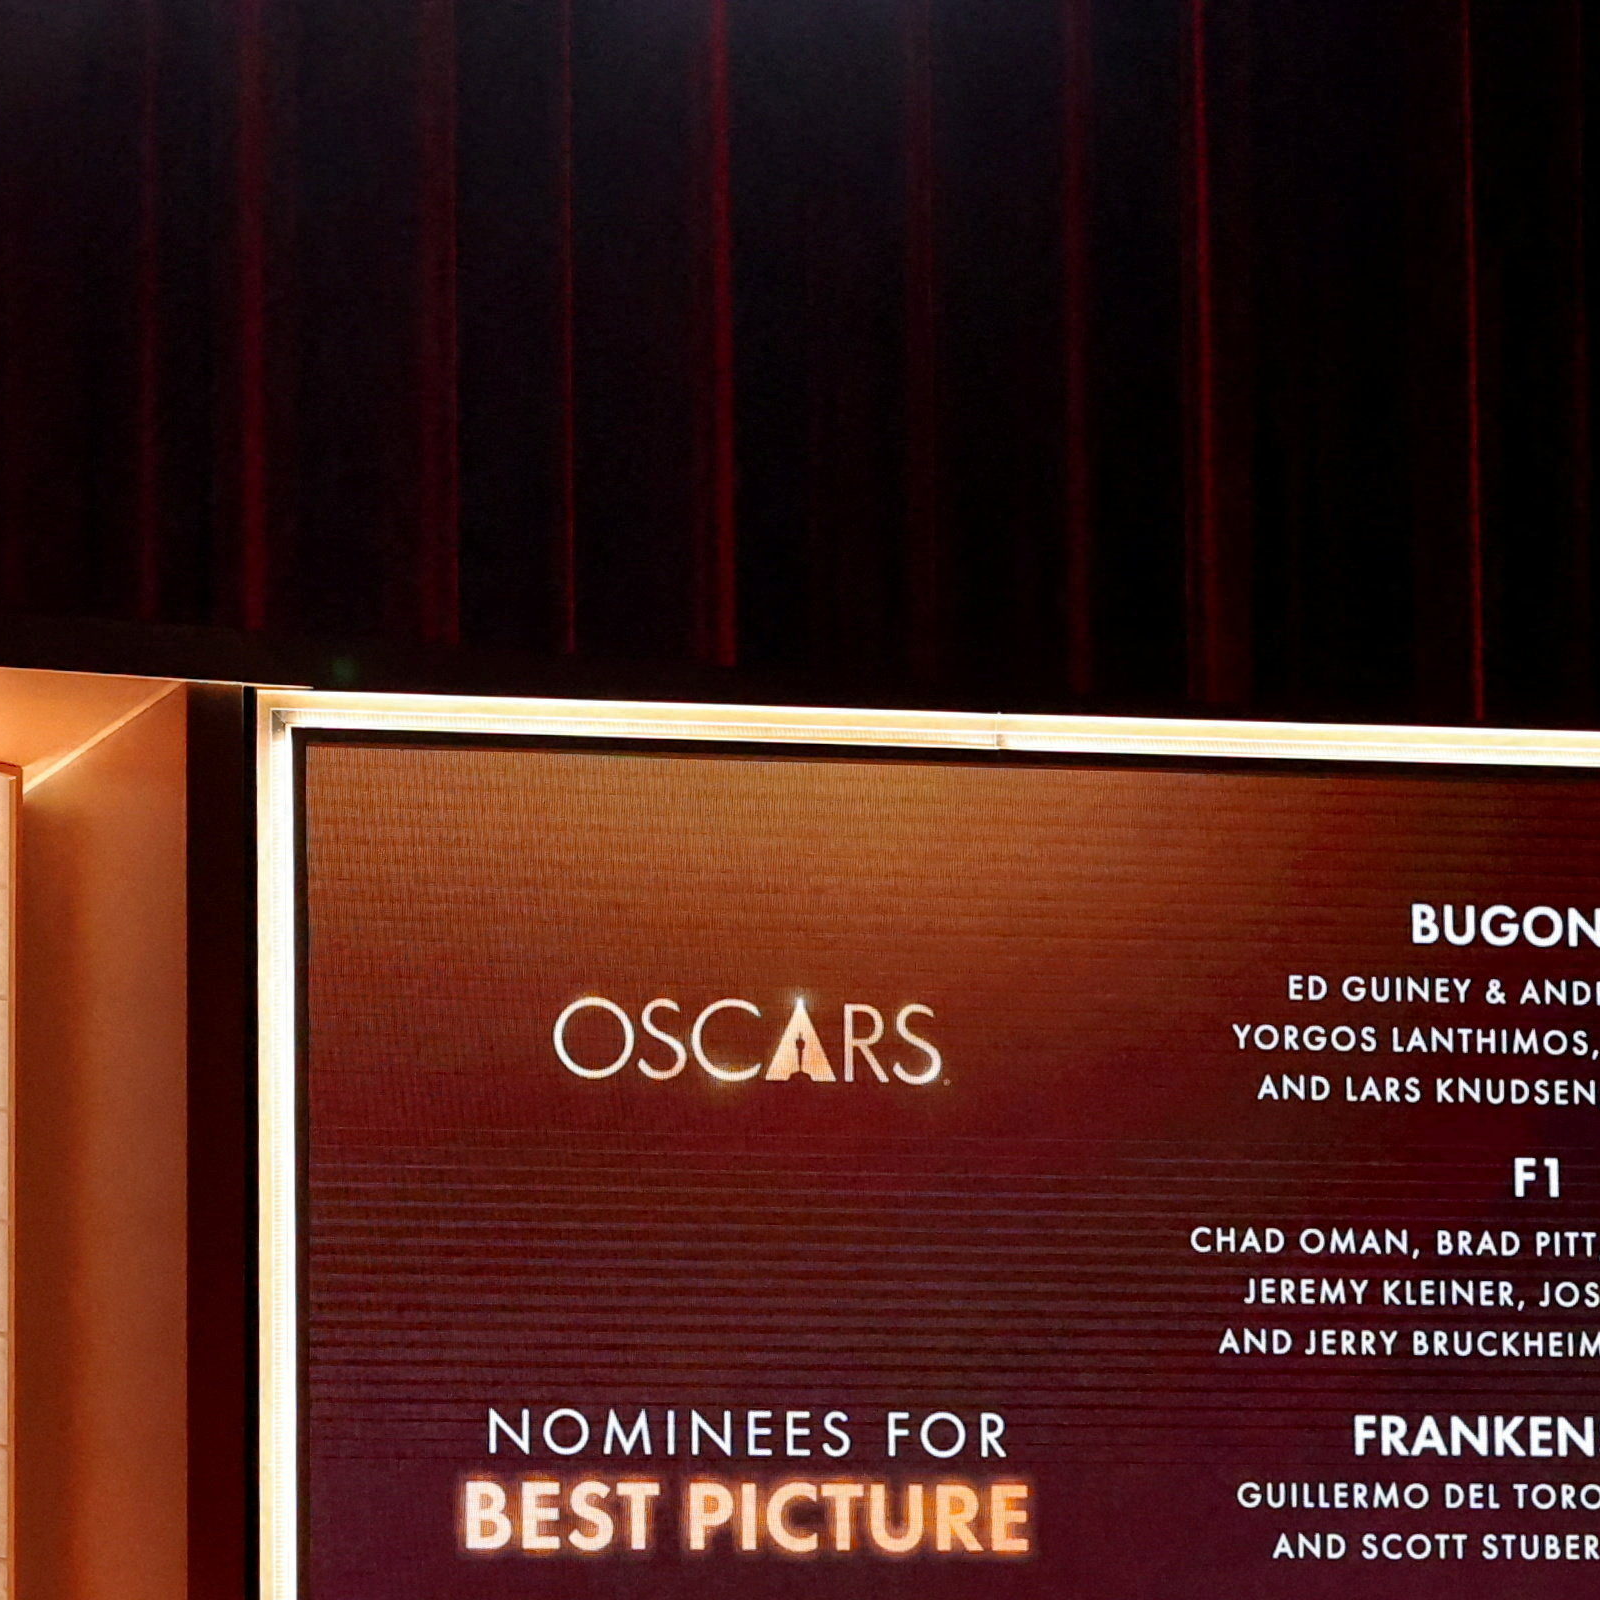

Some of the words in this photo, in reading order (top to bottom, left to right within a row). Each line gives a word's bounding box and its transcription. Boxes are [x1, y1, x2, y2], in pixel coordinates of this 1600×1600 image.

[1288, 974, 1328, 1001] ED
[1341, 976, 1471, 1003] GUINEY
[1485, 978, 1506, 1005] &
[552, 996, 943, 1086] OSCARS
[1232, 1023, 1377, 1052] YORGOS
[1392, 1026, 1599, 1060] LANTHIMOS,
[1257, 1074, 1331, 1101] AND
[1346, 1076, 1421, 1103] LARS
[1514, 1157, 1560, 1198] F1
[1190, 1226, 1285, 1254] CHAD
[1299, 1227, 1420, 1260] OMAN,
[1437, 1229, 1520, 1257] BRAD
[1243, 1278, 1369, 1305] JEREMY
[1383, 1279, 1525, 1312] KLEINER,
[1218, 1328, 1292, 1355] AND
[1304, 1329, 1398, 1356] JERRY
[487, 1407, 851, 1458] NOMINEES
[886, 1411, 1007, 1459] FOR
[1237, 1481, 1429, 1509] GUILLERMO
[1445, 1483, 1500, 1509] DEL
[463, 1479, 661, 1551] BEST
[687, 1481, 1030, 1553] PICTURE
[1272, 1532, 1346, 1559] AND
[1361, 1533, 1468, 1560] SCOTT
